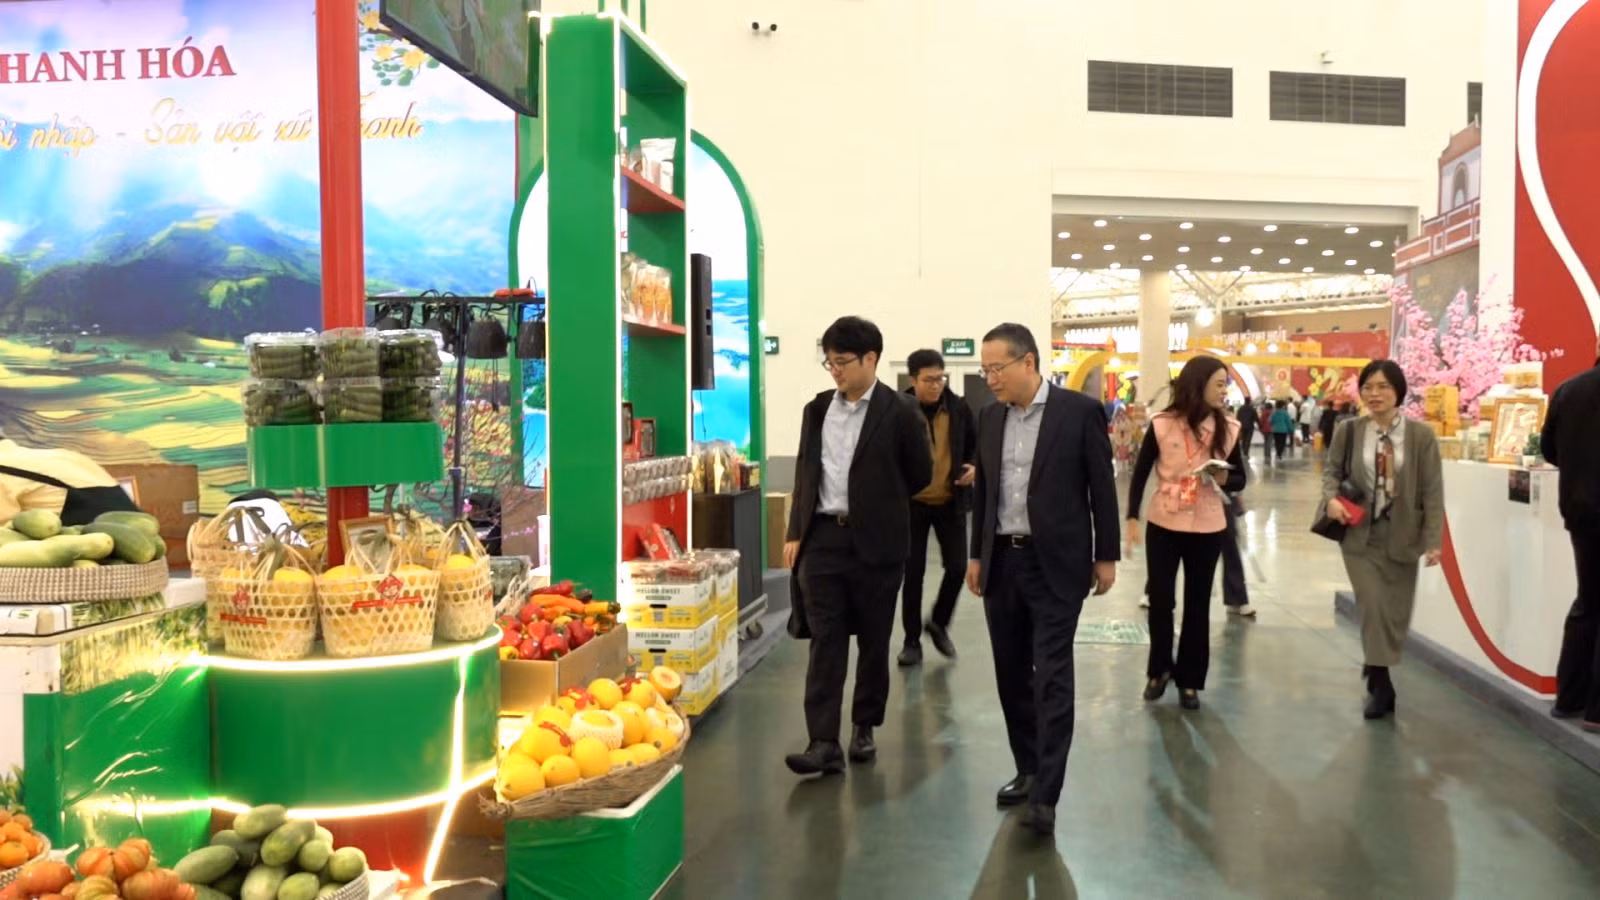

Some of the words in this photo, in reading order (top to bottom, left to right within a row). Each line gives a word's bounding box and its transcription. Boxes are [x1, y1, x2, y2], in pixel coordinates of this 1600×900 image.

[136, 36, 237, 79] HÓA
[30, 112, 98, 158] nhập
[144, 97, 201, 145] Sản
[213, 110, 265, 152] vật
